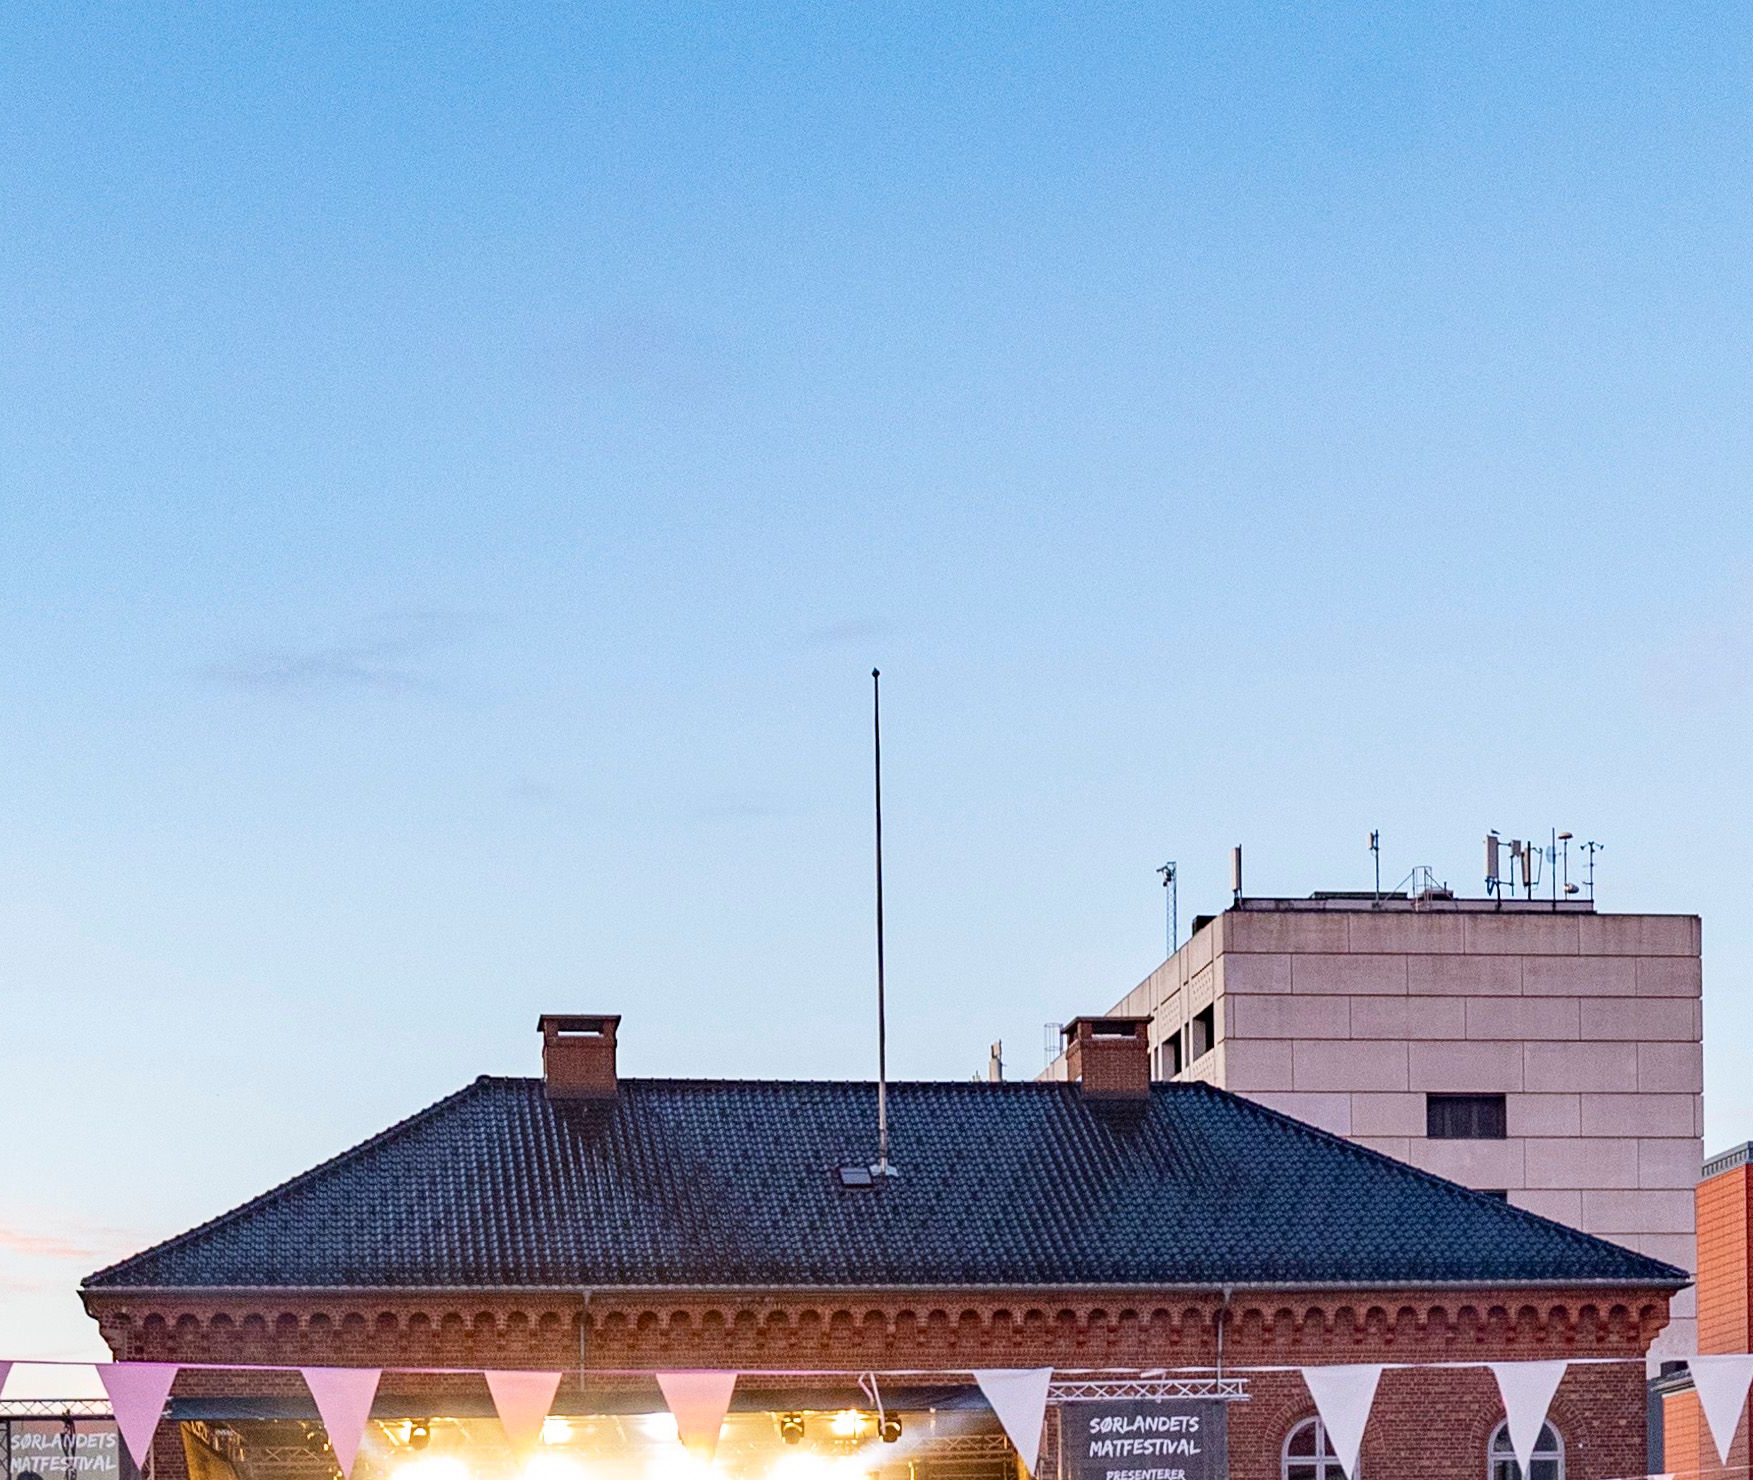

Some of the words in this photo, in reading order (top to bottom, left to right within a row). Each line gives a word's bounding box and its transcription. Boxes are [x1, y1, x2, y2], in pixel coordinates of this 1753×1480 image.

[1089, 1416, 1200, 1434] SØRLANDETS
[10, 1432, 117, 1451] SØRLANDETS
[1089, 1439, 1201, 1457] MATFESTIVAL
[10, 1456, 117, 1474] MATFESTIVAL
